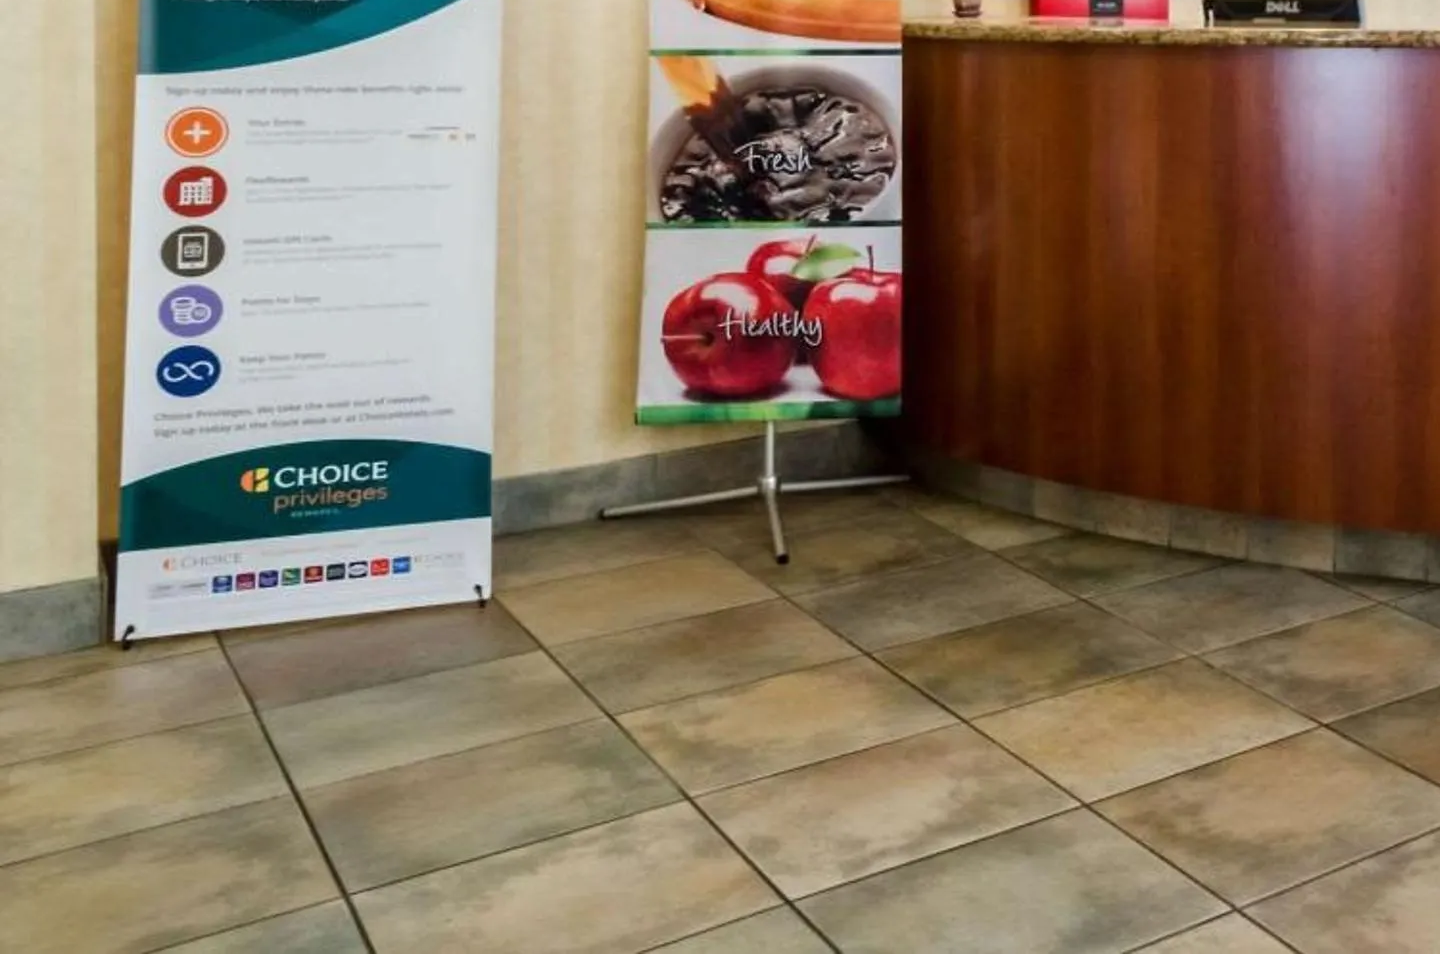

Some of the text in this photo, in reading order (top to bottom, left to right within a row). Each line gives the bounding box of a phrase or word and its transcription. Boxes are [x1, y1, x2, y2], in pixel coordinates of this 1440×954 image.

[1266, 0, 1301, 14] DELL
[734, 141, 813, 175] Fresh
[717, 307, 823, 346] Healthy
[273, 459, 389, 489] CHOICE
[273, 486, 388, 515] privileges
